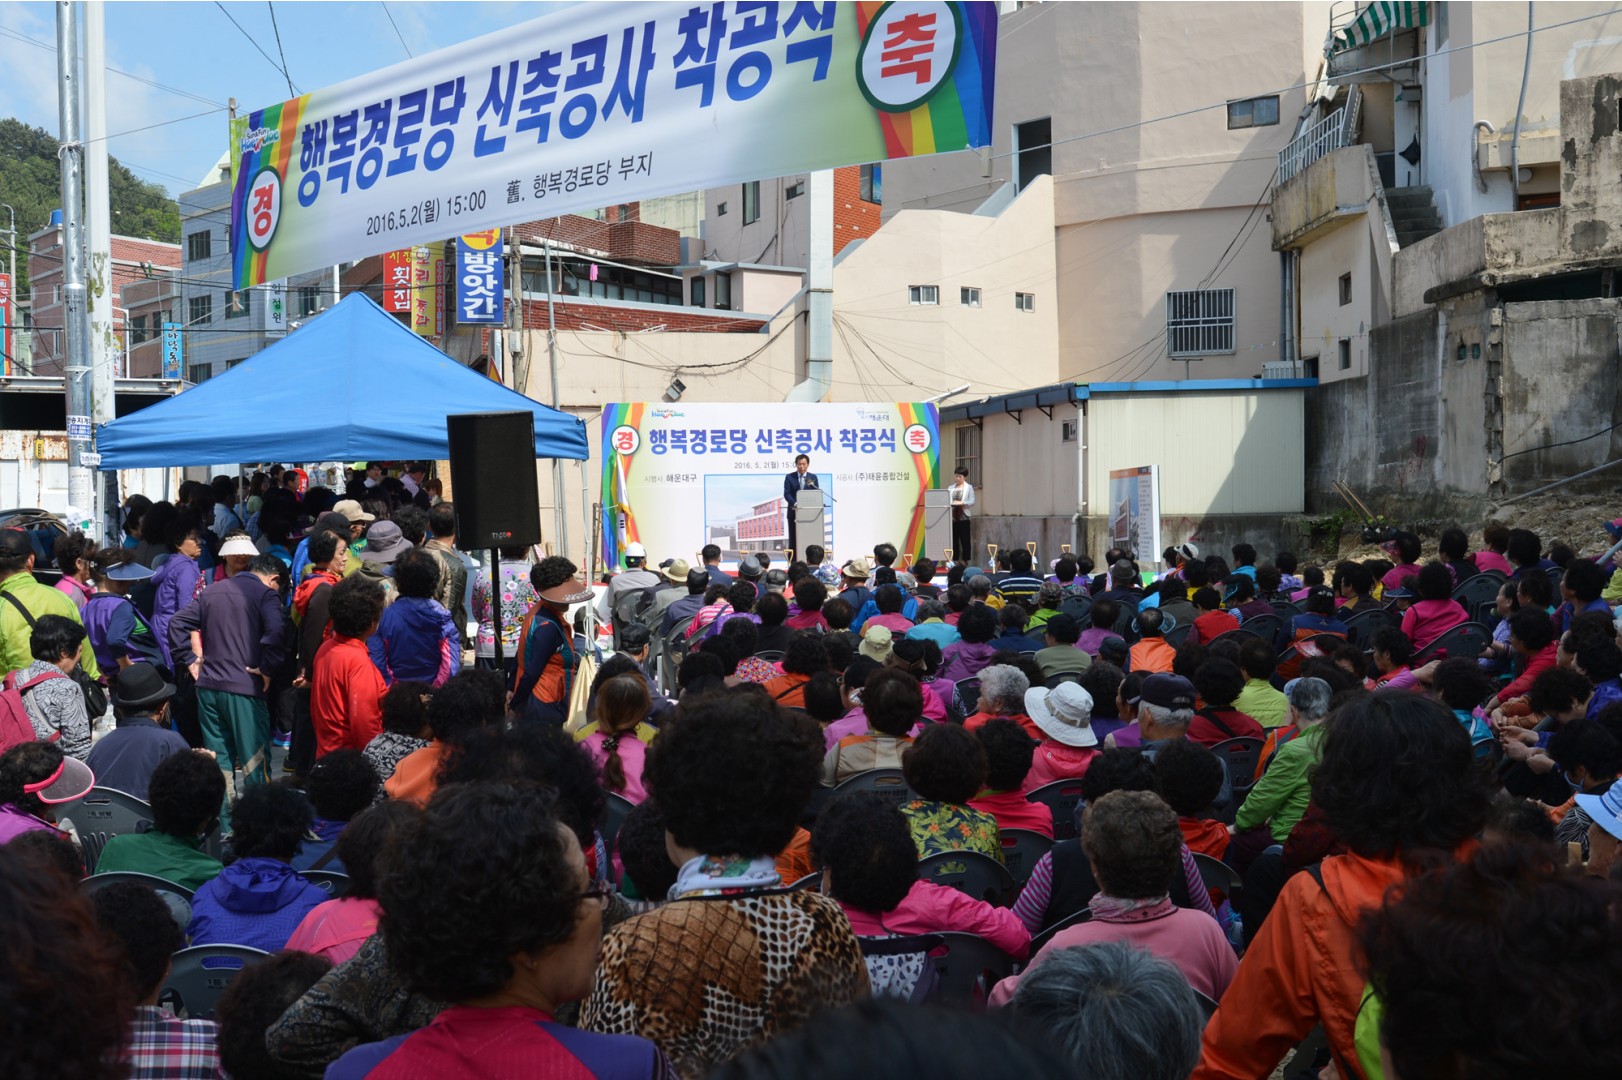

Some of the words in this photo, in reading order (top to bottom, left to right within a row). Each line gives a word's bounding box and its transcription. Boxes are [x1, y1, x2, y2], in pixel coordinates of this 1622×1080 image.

[881, 12, 938, 85] 축
[297, 75, 467, 208] 행복경로당
[473, 20, 657, 159] 신축공사
[673, 1, 837, 109] 착공식
[251, 182, 274, 238] 경
[366, 196, 441, 237] 2016.5.2(월)
[446, 189, 487, 218] 15:00
[533, 161, 613, 201] 행복경로당
[617, 151, 654, 181] 부지
[392, 266, 411, 310] 횟집
[463, 252, 499, 319] 방앗간
[616, 432, 635, 451] 경
[649, 428, 748, 455] 행복경로당
[755, 427, 833, 455] 신축공사
[839, 427, 896, 454] 착공식
[909, 430, 927, 449] 축
[665, 473, 697, 483] 해운대구
